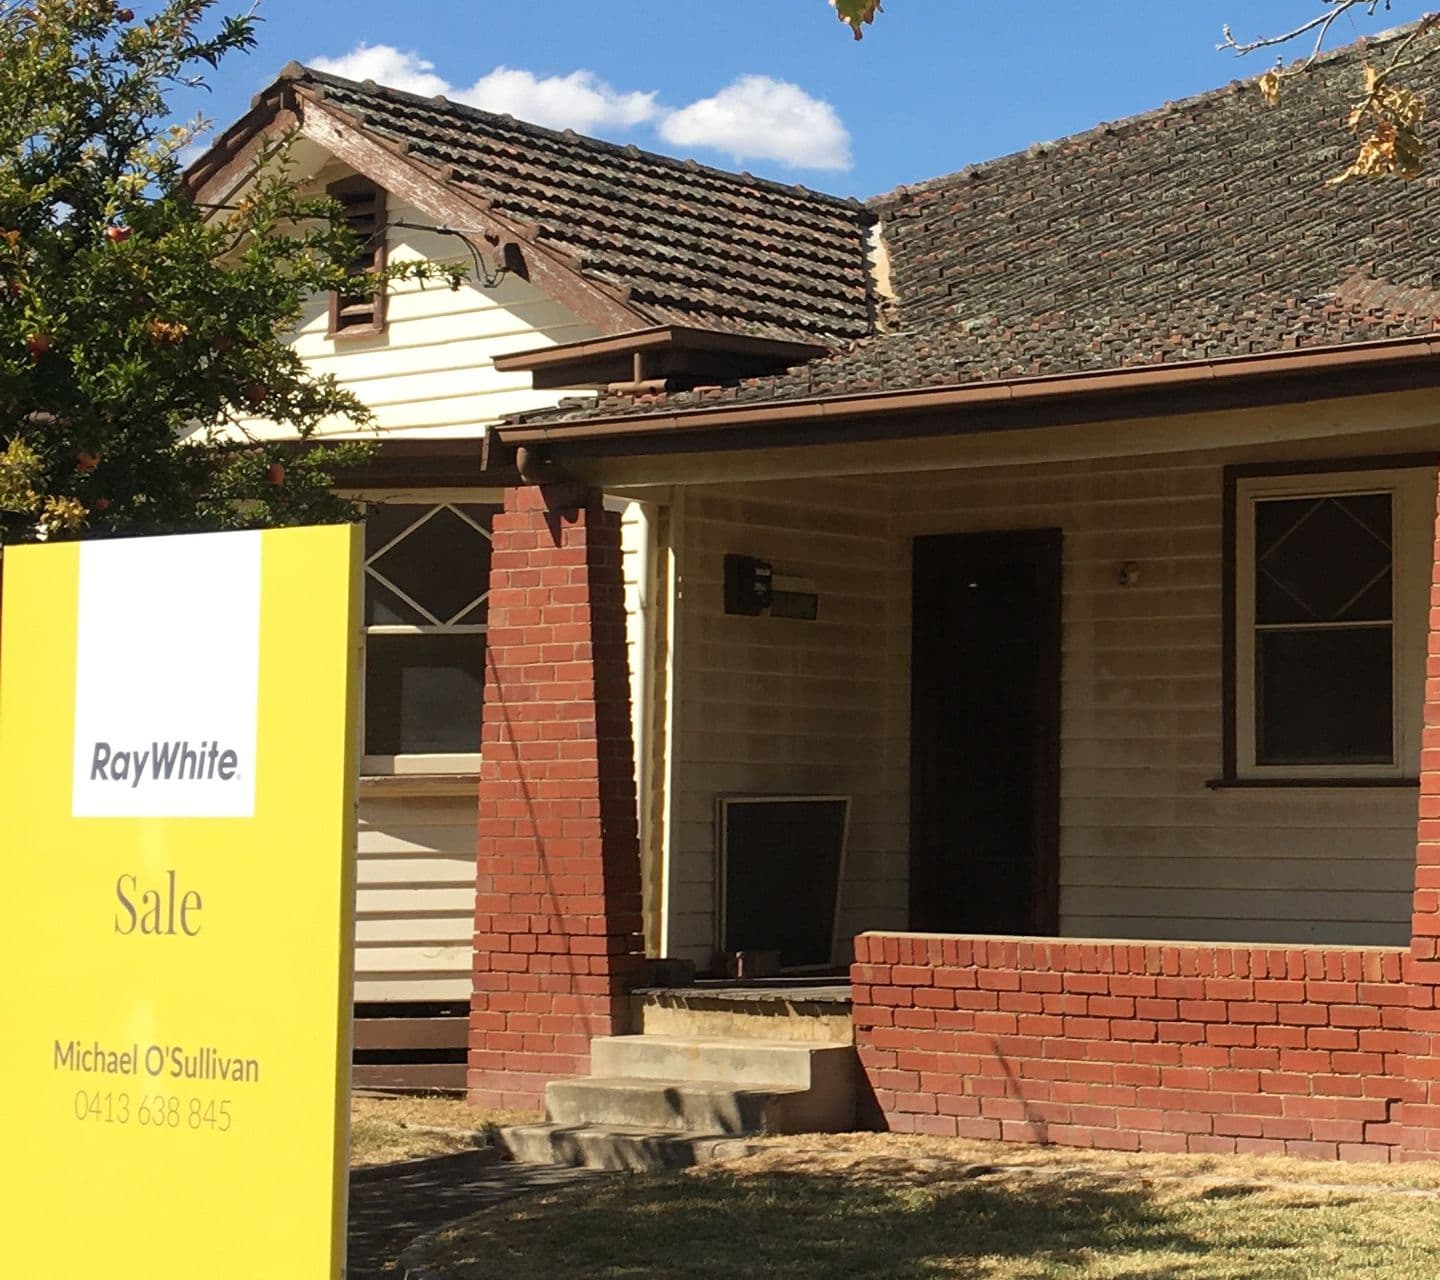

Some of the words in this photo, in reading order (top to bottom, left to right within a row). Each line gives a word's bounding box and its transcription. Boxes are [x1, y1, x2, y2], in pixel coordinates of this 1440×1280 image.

[114, 870, 203, 936] Sale
[53, 1039, 138, 1076] Michael
[144, 1045, 260, 1083] O'Sullivan
[74, 1089, 131, 1124] 0413
[138, 1095, 181, 1128] 638
[188, 1099, 232, 1132] 845
